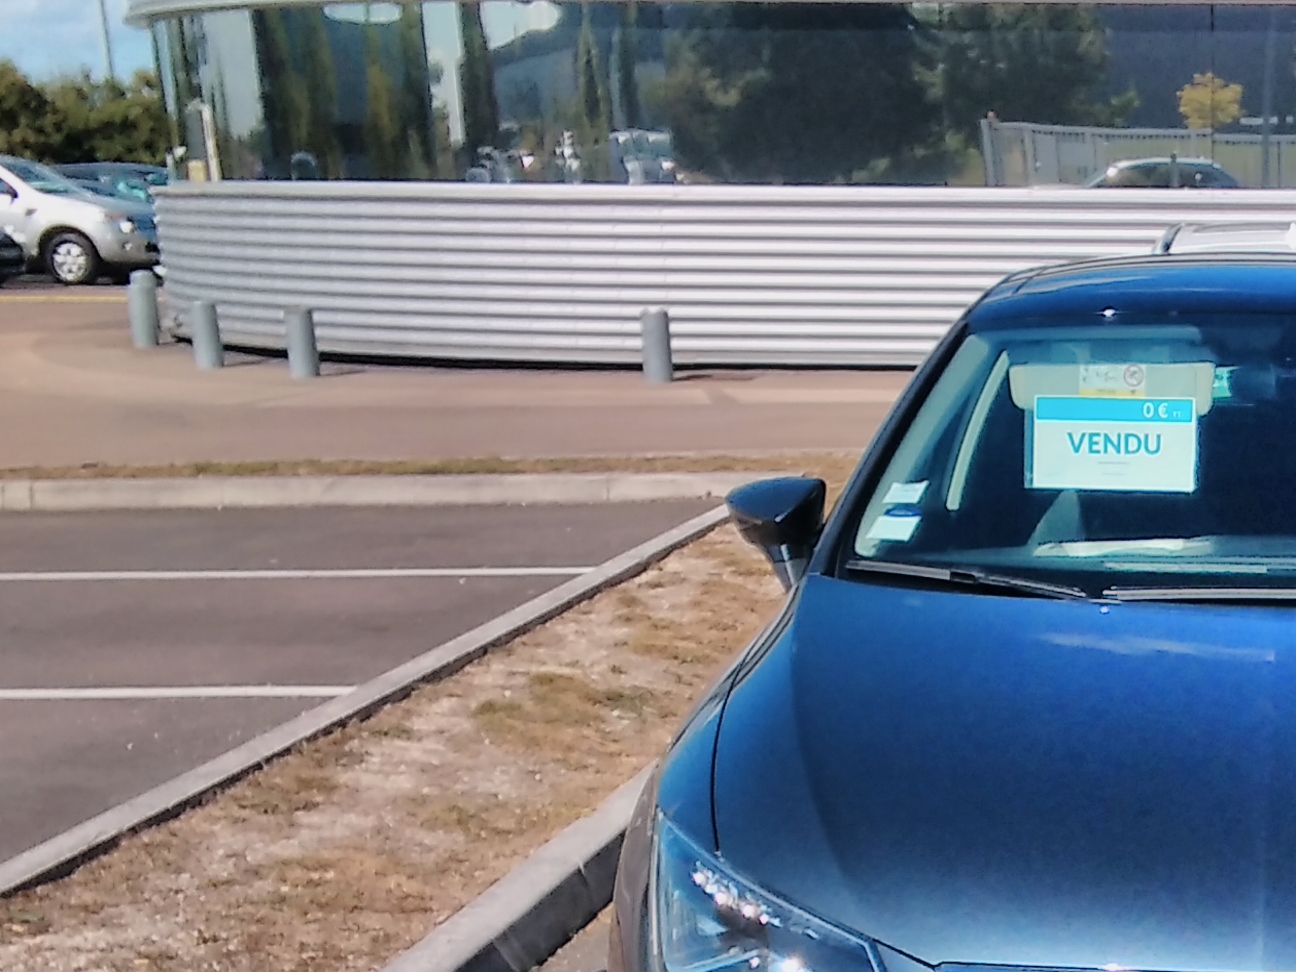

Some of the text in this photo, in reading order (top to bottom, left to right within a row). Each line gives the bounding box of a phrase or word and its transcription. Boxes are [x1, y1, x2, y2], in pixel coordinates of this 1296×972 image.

[1143, 402, 1155, 418] 0
[1158, 402, 1169, 418] €
[1067, 432, 1162, 455] VENDU
